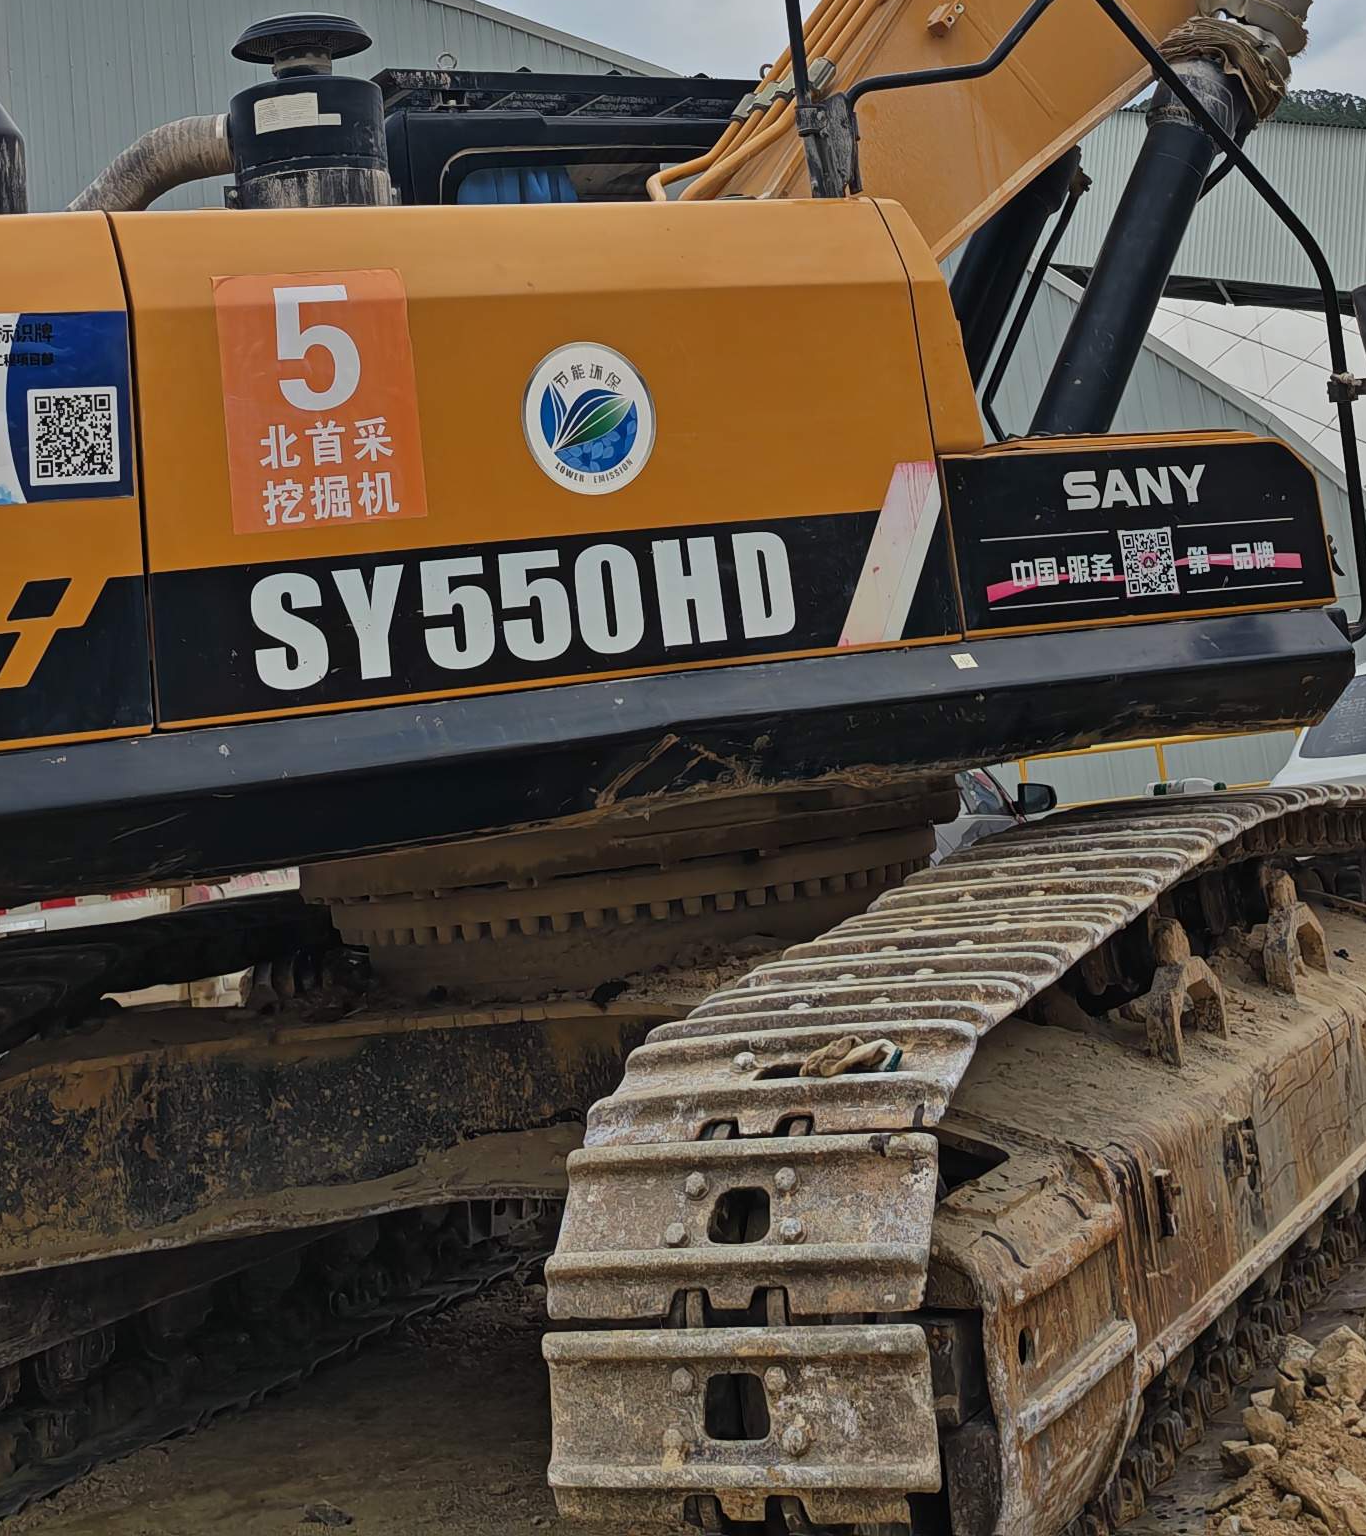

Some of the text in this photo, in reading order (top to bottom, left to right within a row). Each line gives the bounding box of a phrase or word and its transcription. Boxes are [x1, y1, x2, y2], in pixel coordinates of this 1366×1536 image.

[271, 284, 361, 412] 5
[553, 364, 622, 391] 节能环保
[259, 416, 395, 470] 北首采
[554, 459, 633, 484] LOWER EMISSION
[1062, 464, 1206, 511] SANY
[262, 472, 400, 526] 挖掘机
[250, 531, 796, 690] SY550HD
